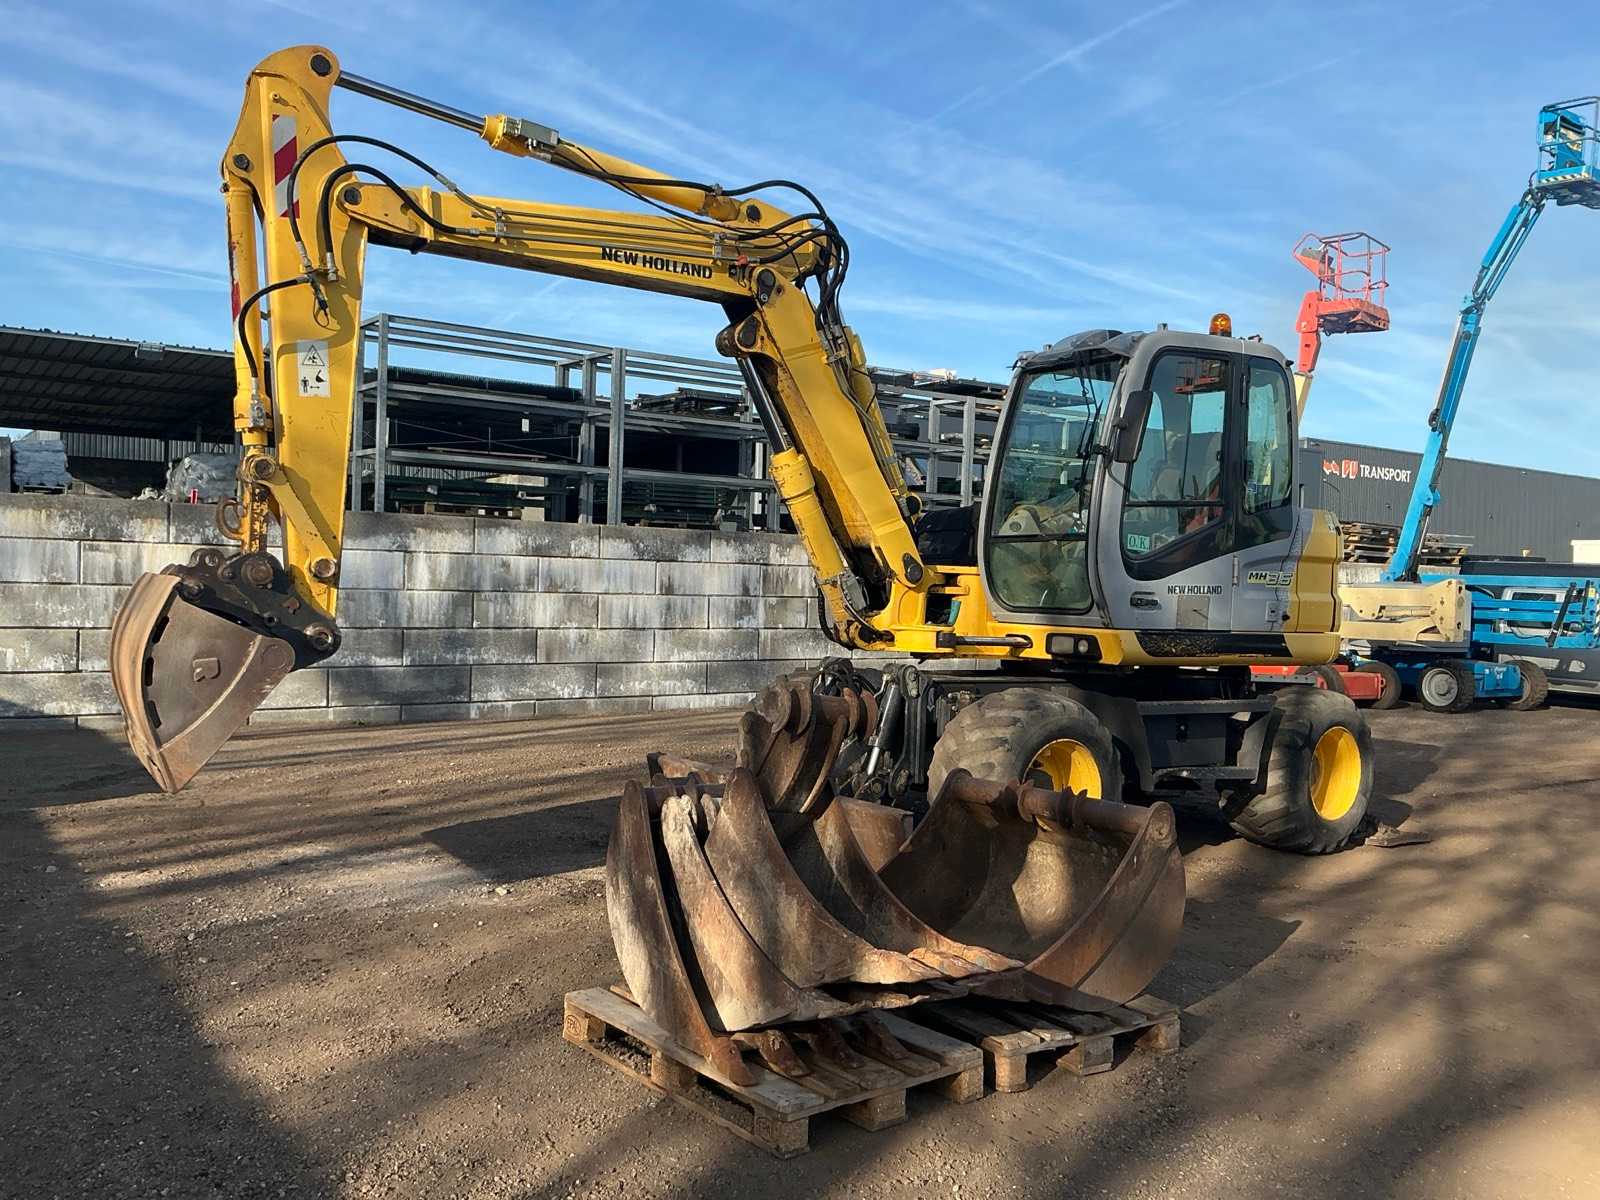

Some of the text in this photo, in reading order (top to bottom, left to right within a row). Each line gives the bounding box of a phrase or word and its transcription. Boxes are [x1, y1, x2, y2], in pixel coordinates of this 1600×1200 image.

[601, 247, 713, 279] NEW HOLLAND
[1360, 464, 1412, 483] TRANSPORT
[1167, 585, 1223, 595] NEW HOLLAND
